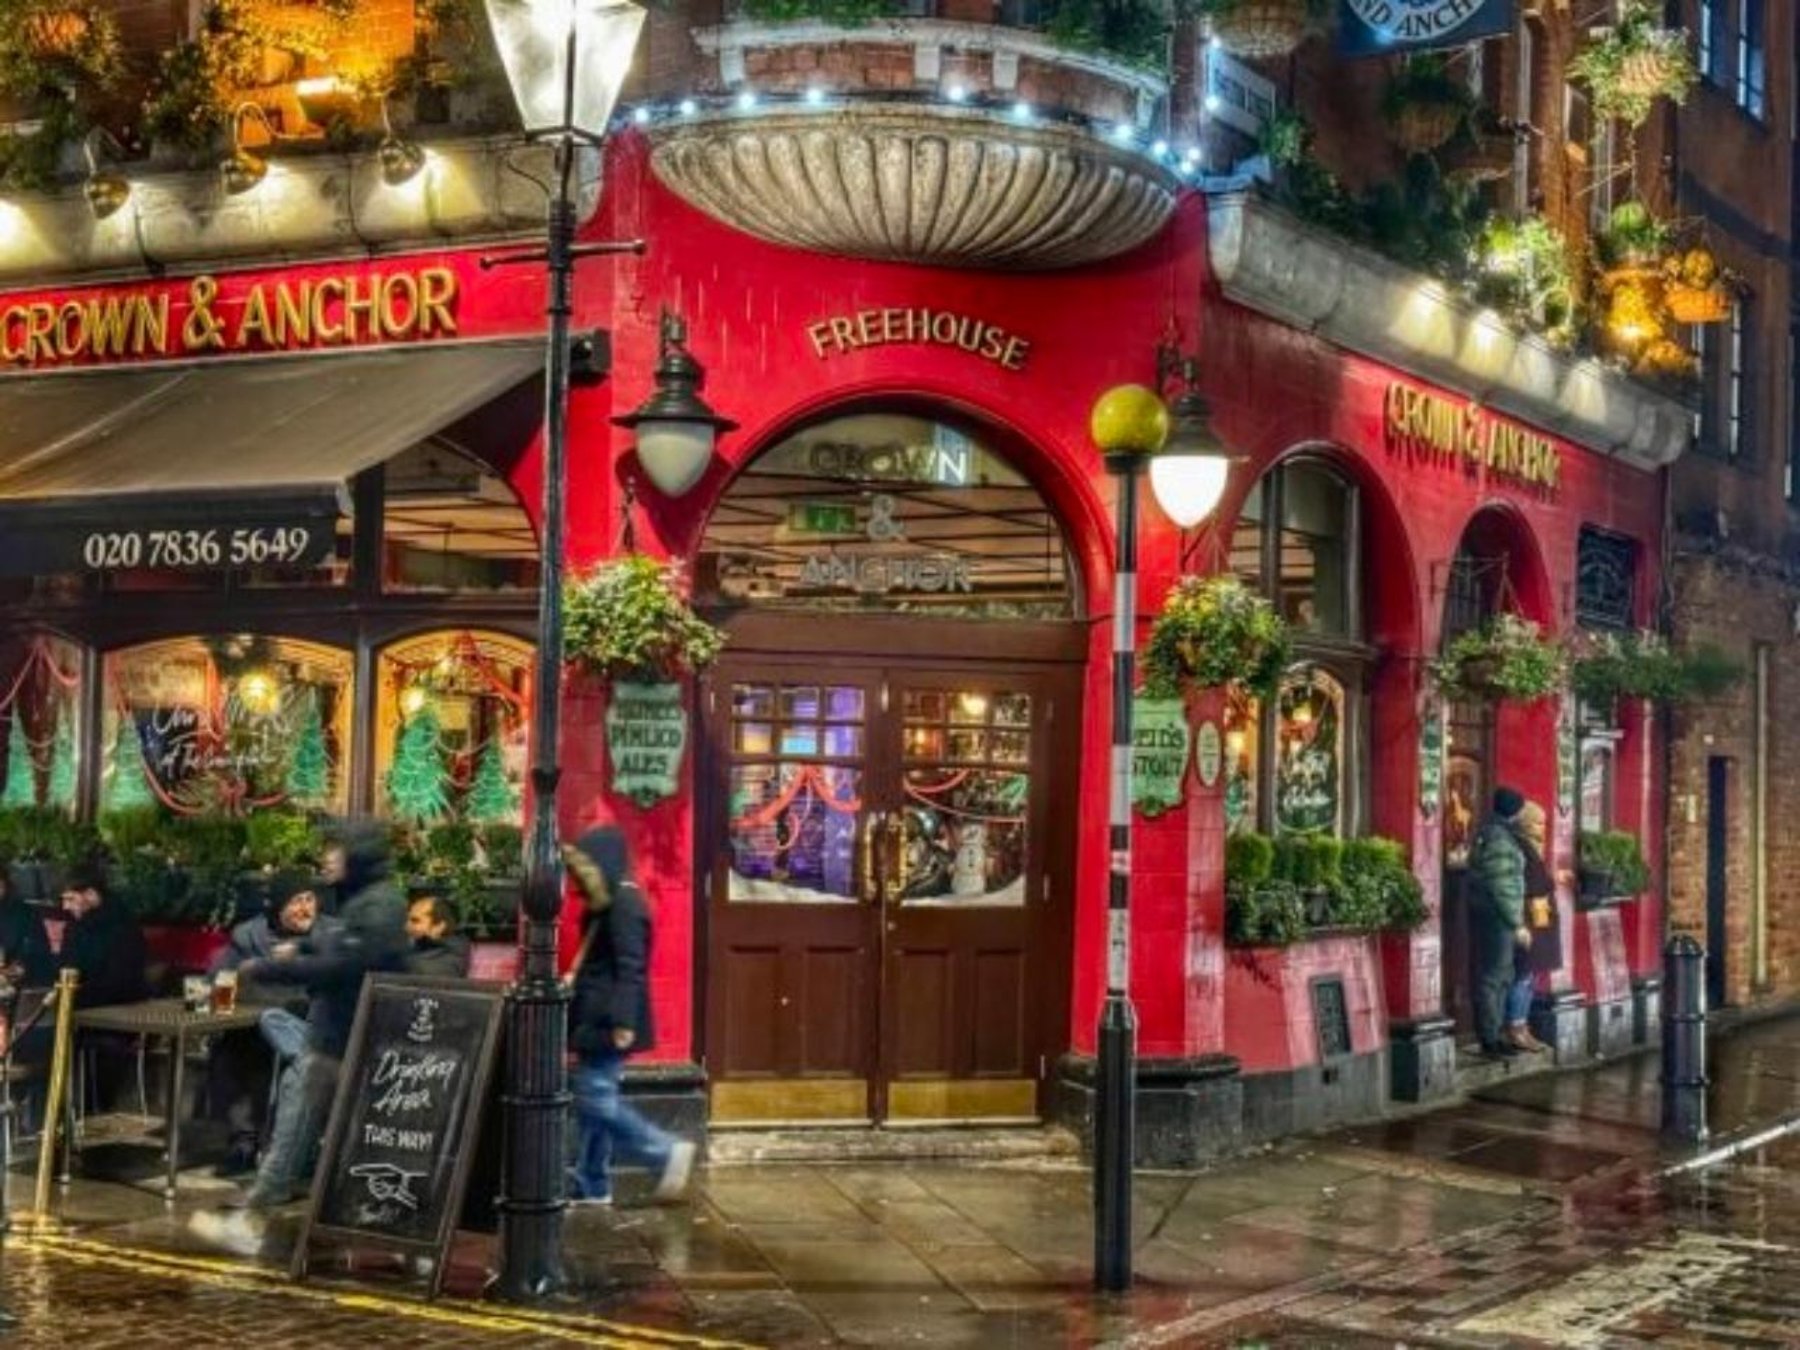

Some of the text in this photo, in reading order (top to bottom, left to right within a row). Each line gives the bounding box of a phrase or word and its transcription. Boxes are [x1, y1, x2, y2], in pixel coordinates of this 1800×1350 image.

[1351, 0, 1474, 36] ND ANCH
[1, 267, 458, 360] CROWN & ANCHOR
[807, 307, 1030, 370] FREEHOUSE
[810, 442, 967, 486] CROWN
[867, 494, 909, 543] &
[84, 527, 309, 568] 020 7836 5649
[801, 553, 973, 592] ANCHOR
[611, 724, 681, 748] PIMLICO
[620, 750, 667, 775] ALES
